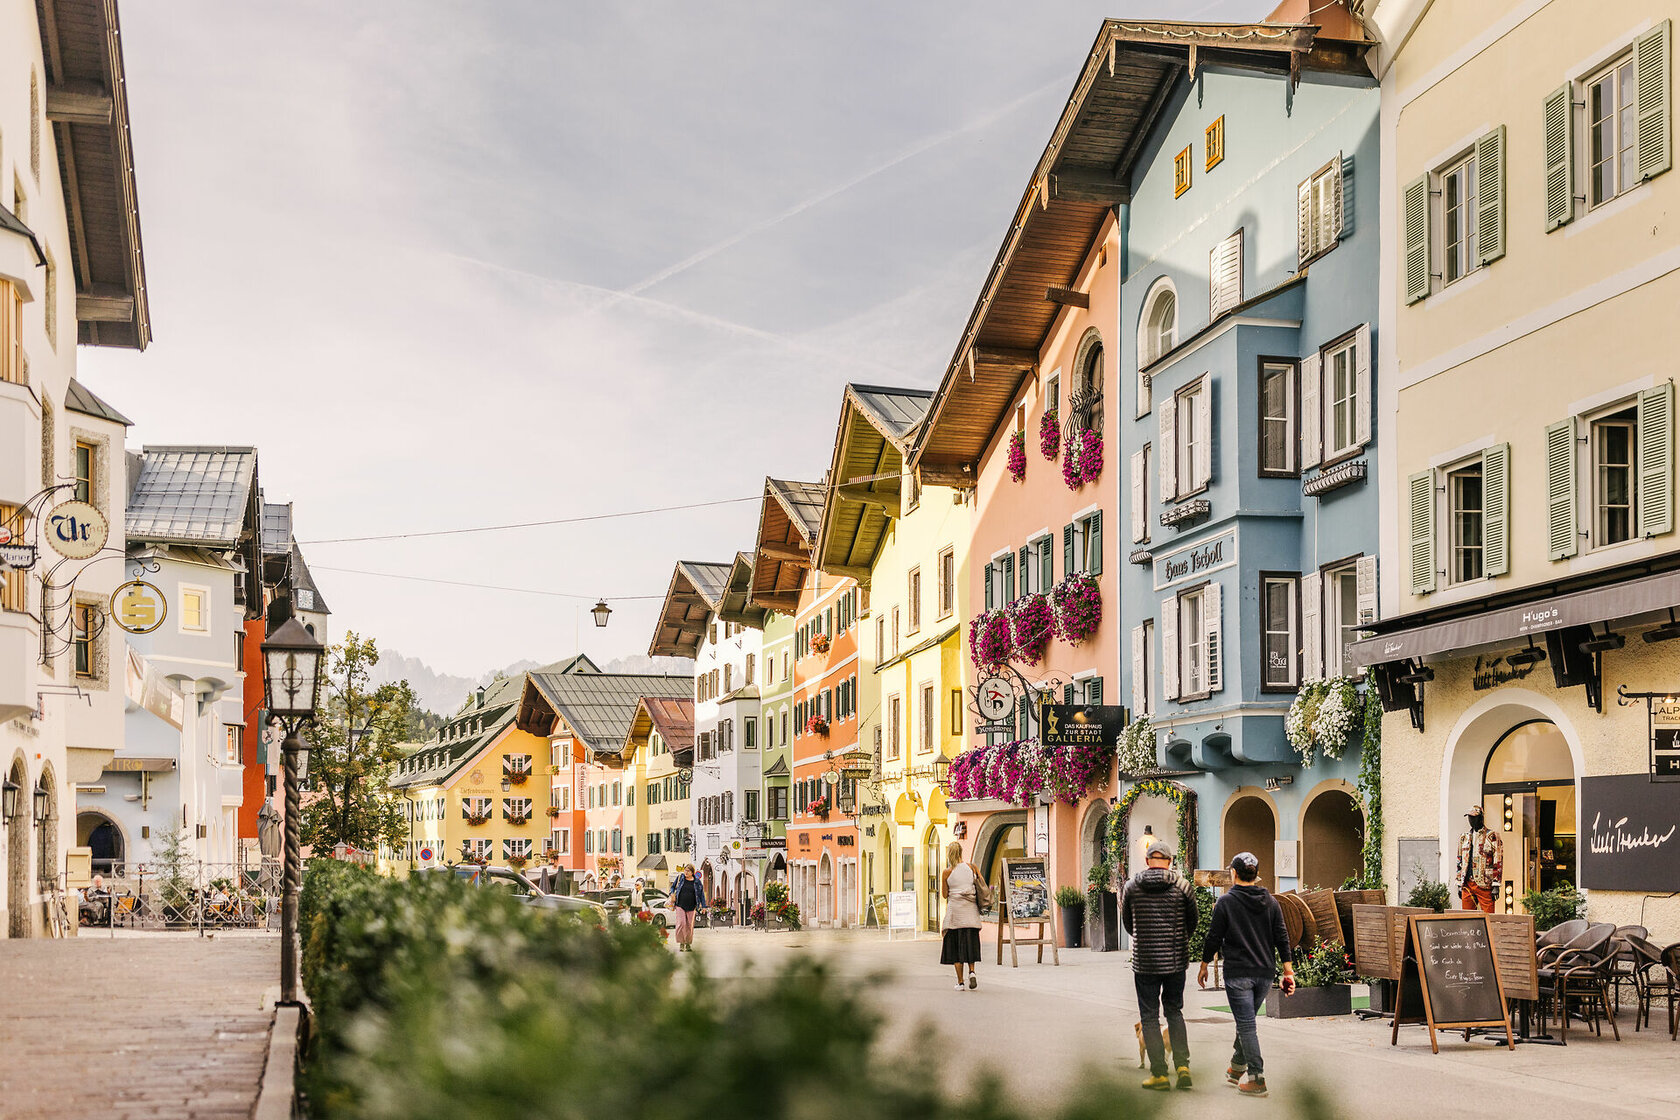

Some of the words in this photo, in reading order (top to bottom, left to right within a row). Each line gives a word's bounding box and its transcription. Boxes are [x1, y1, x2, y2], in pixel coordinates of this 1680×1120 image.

[1190, 541, 1223, 573] Tscholl
[1522, 606, 1558, 622] H'ugo's
[1591, 812, 1614, 853] Luis
[1614, 817, 1676, 852] Trenker
